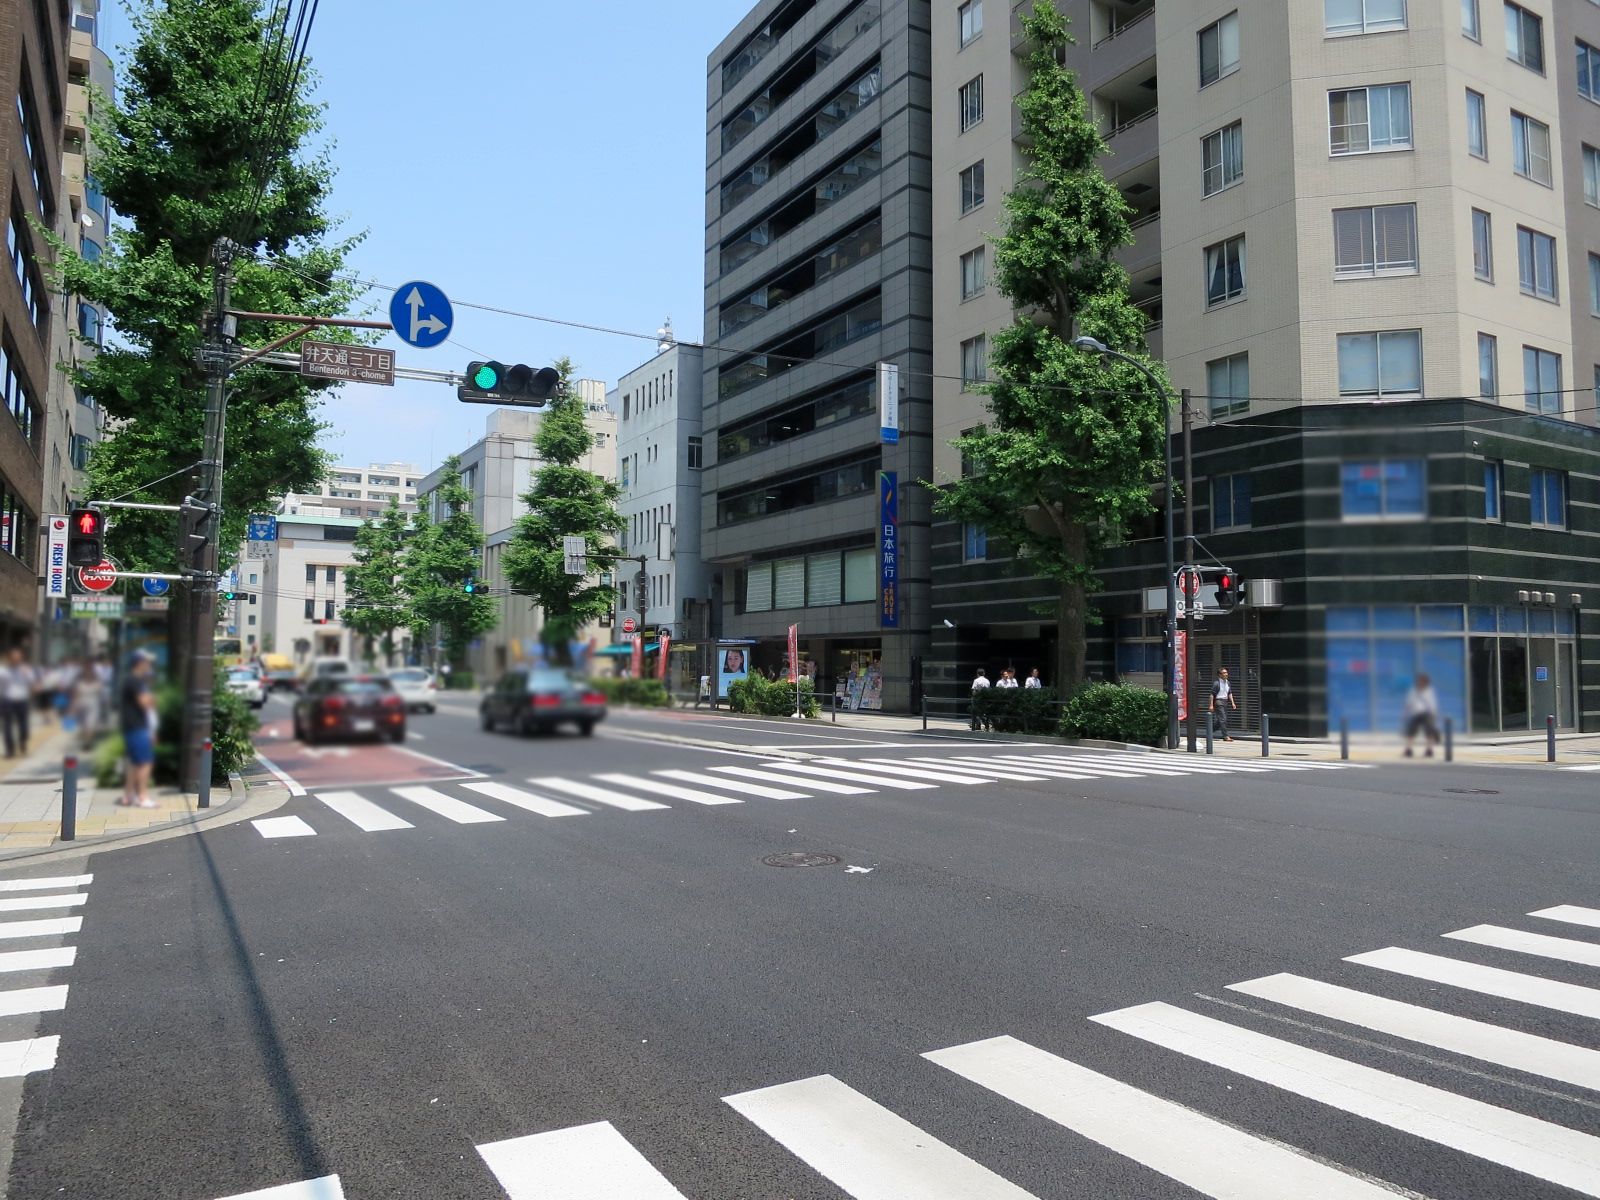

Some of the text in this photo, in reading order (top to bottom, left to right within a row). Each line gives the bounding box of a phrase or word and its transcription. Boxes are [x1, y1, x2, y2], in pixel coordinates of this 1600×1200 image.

[305, 346, 391, 370] 弁天通三丁目
[309, 363, 350, 376] Bentendori
[52, 543, 64, 566] FRESH
[883, 524, 895, 578] 日本旅行
[51, 568, 63, 593] HOUSE
